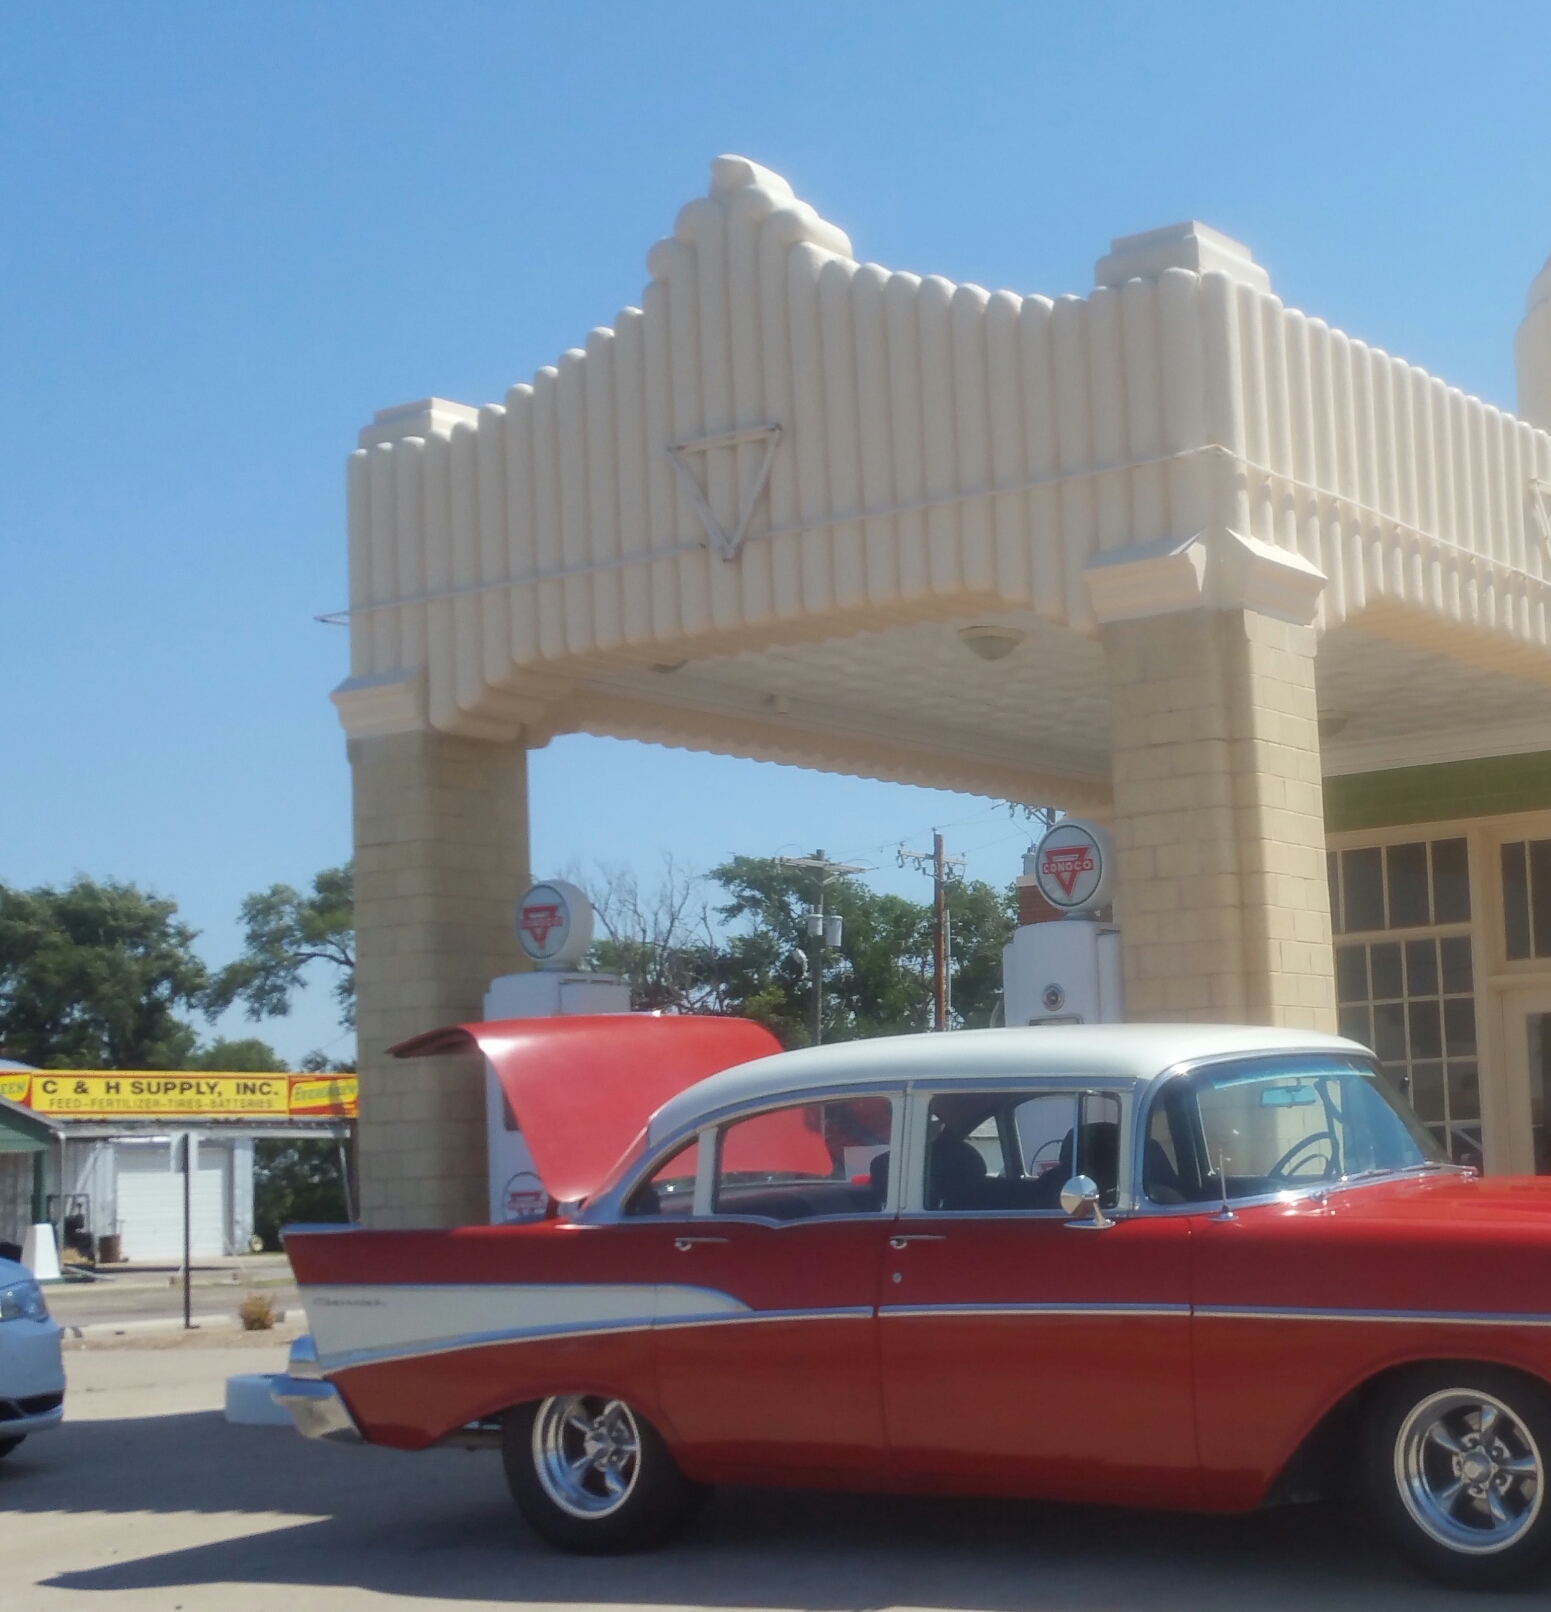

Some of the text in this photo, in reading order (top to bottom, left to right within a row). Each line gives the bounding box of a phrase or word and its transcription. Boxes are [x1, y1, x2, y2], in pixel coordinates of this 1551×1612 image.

[1043, 860, 1092, 873] CONOCO
[42, 1080, 279, 1097] C & H SUPPLY, INC.
